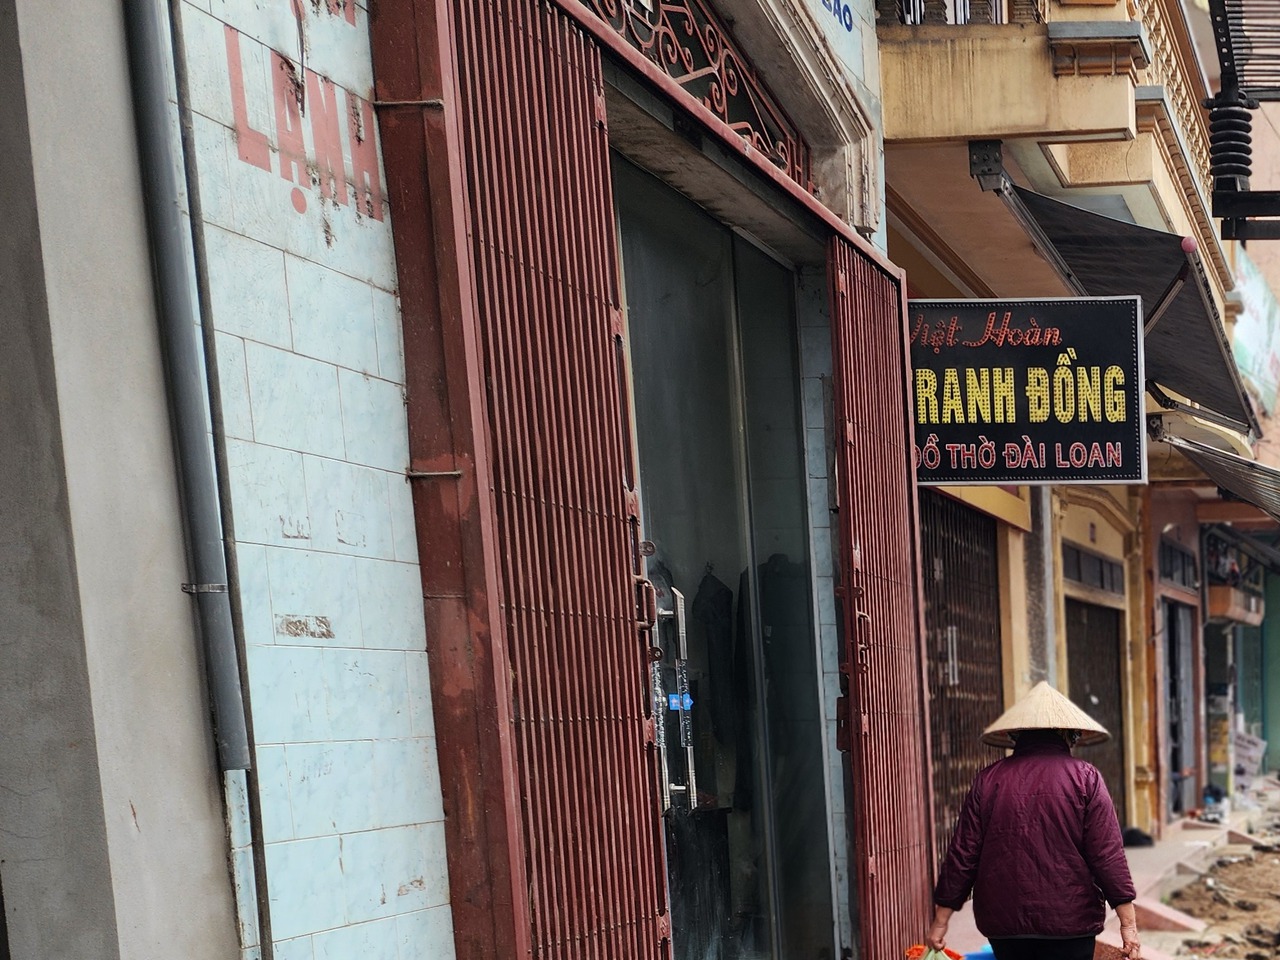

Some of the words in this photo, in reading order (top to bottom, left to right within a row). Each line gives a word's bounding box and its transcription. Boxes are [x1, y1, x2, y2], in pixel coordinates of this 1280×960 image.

[962, 312, 1062, 347] Hoàn
[911, 366, 1016, 424] RANH
[1025, 347, 1127, 423] ĐỒNG
[945, 435, 996, 469] THỜ
[1002, 435, 1046, 468] ĐÀI
[1055, 441, 1122, 468] LOAN
